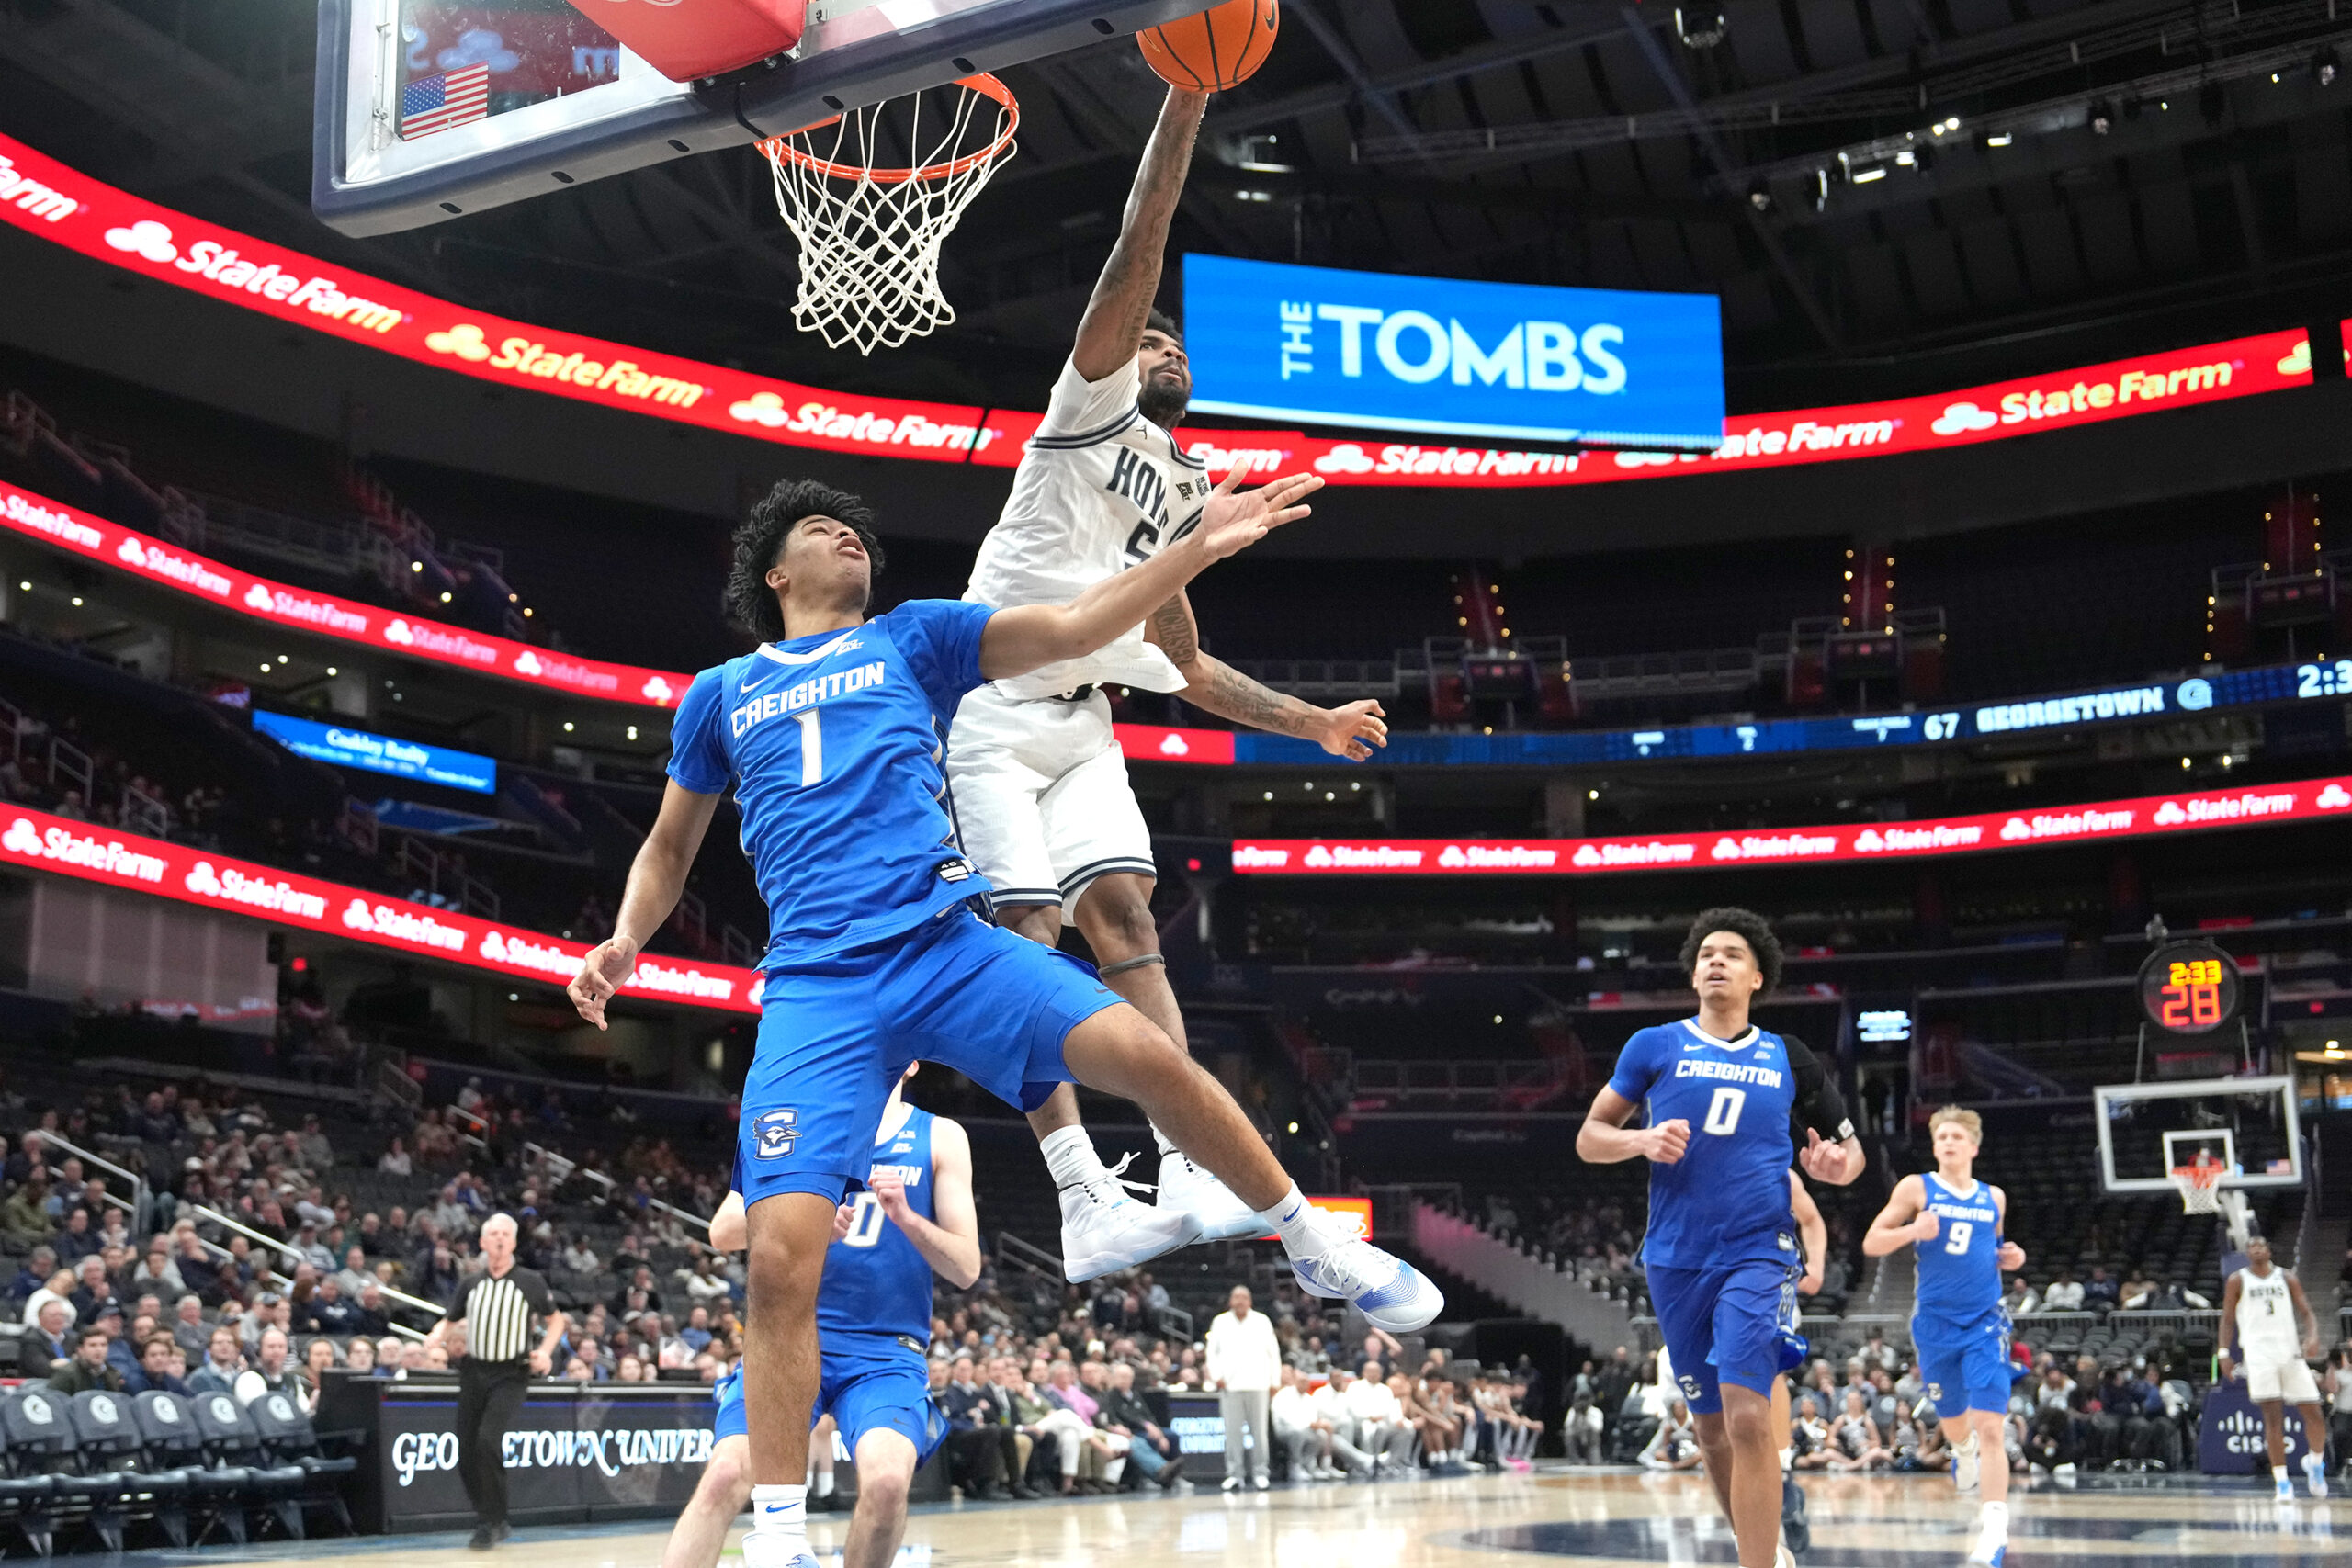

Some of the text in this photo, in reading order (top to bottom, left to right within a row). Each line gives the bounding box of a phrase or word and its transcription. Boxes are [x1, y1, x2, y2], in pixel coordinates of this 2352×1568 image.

[1280, 300, 1628, 395] THE TOMBS
[730, 661, 885, 739] CREIGHTON
[1924, 713, 1960, 740] 67
[1976, 687, 2165, 732] GEORGETOWN
[791, 706, 822, 787] 1
[505, 936, 586, 976] StateFar
[2169, 959, 2222, 986] 2:33
[2161, 983, 2222, 1026] 28
[1675, 1059, 1782, 1089] CREIGHTON
[1703, 1087, 1747, 1135] 0
[1945, 1221, 1973, 1255] 9
[392, 1429, 620, 1487] GEOETOWN
